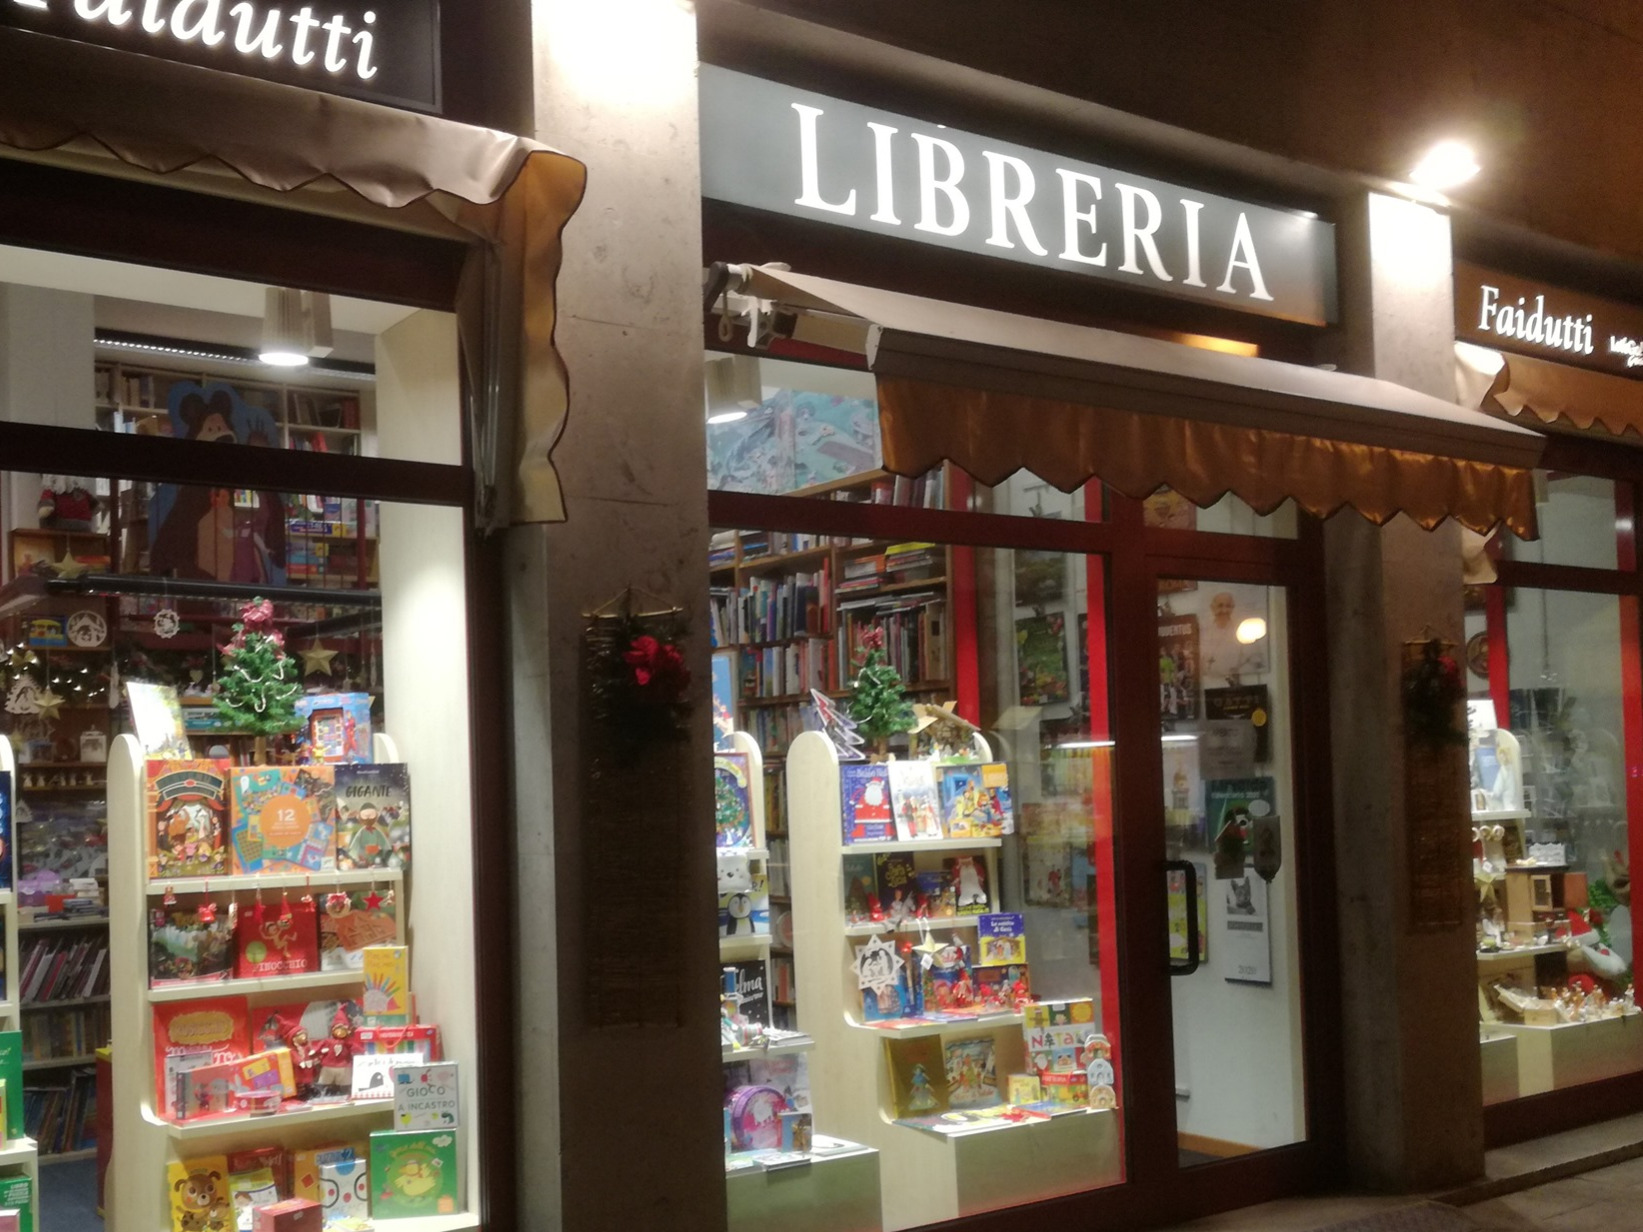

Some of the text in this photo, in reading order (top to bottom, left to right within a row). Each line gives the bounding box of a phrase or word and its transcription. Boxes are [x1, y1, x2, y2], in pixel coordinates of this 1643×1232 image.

[14, 0, 377, 79] aidutti
[791, 103, 1274, 301] LIBRERIA
[1478, 285, 1594, 354] Faidutti
[345, 784, 392, 798] GIGANTE
[277, 809, 296, 821] 12
[406, 1083, 446, 1098] GIOCO
[398, 1100, 455, 1112] A INCASTRO
